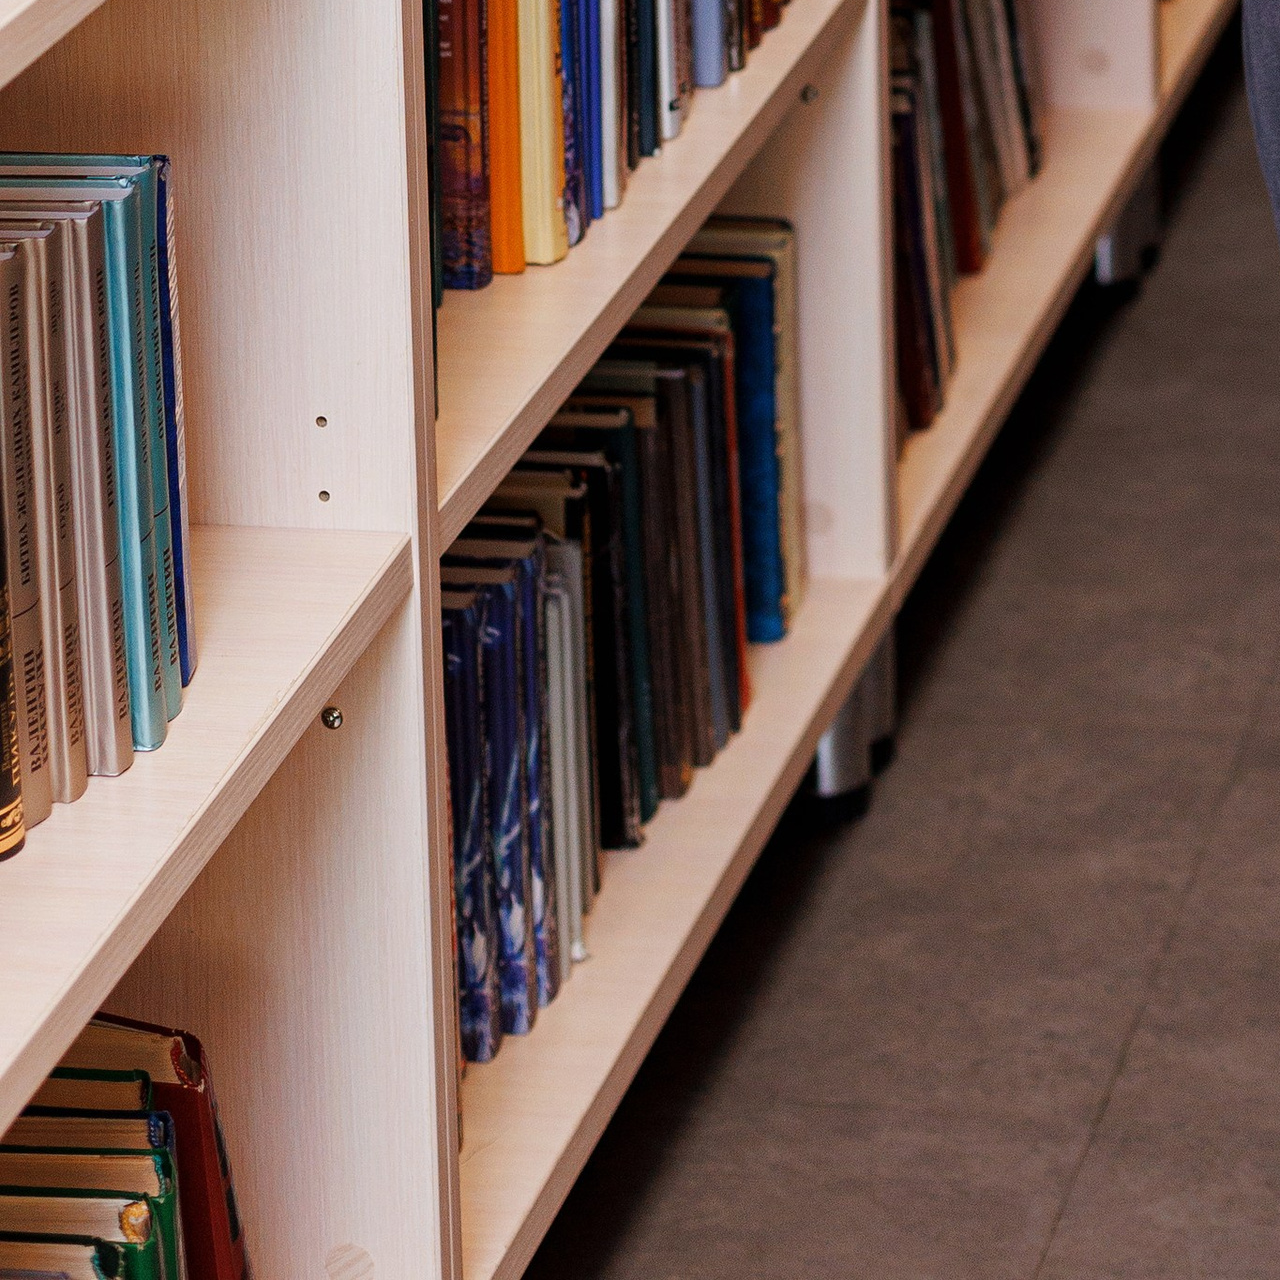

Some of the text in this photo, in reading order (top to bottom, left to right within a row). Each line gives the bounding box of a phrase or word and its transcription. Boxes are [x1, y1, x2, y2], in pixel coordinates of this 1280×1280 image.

[133, 260, 149, 464] ОКЕАНСКИЙ ПАТРУЛЬ
[149, 238, 164, 439] ОКЕАНСКИЙ ПАТРУЛЬ
[8, 283, 31, 585] БИТВА ЖЕЛЕЗНЫХ КАНЦЛЕРОВ
[112, 600, 127, 721] ВАЛЕНТИН
[147, 571, 162, 693] ВАЛЕНТИН
[163, 547, 178, 667] ВАЛЕНТИН
[23, 649, 42, 774] ВАЛЕНТИН
[64, 624, 79, 747] ВАЛЕНТИН
